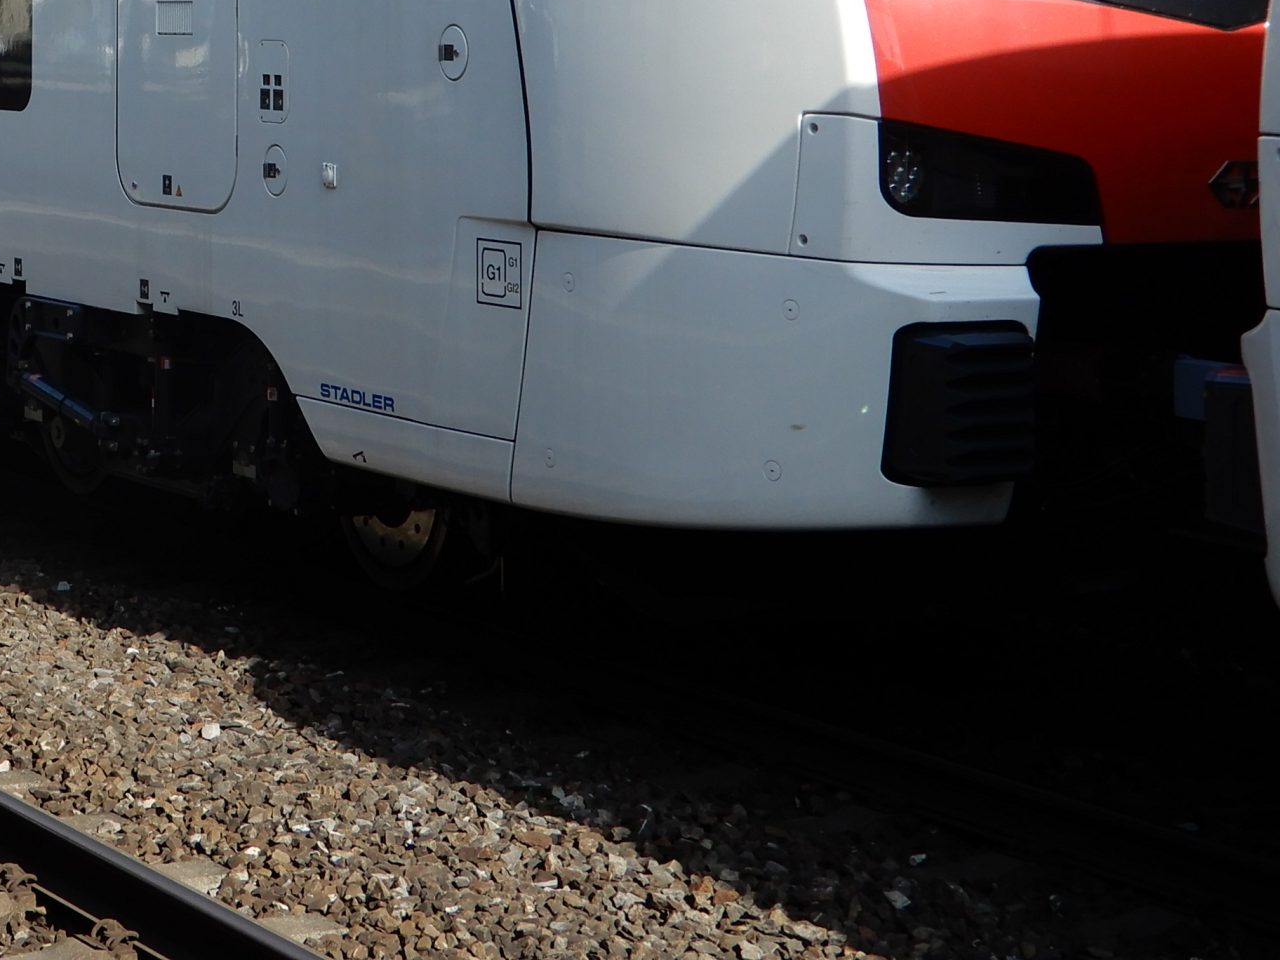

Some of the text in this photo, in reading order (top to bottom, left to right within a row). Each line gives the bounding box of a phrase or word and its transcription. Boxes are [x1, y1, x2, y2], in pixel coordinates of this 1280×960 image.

[508, 256, 518, 268] G1
[486, 263, 502, 282] G1
[231, 300, 244, 317] 3L
[320, 383, 395, 412] STADLER
